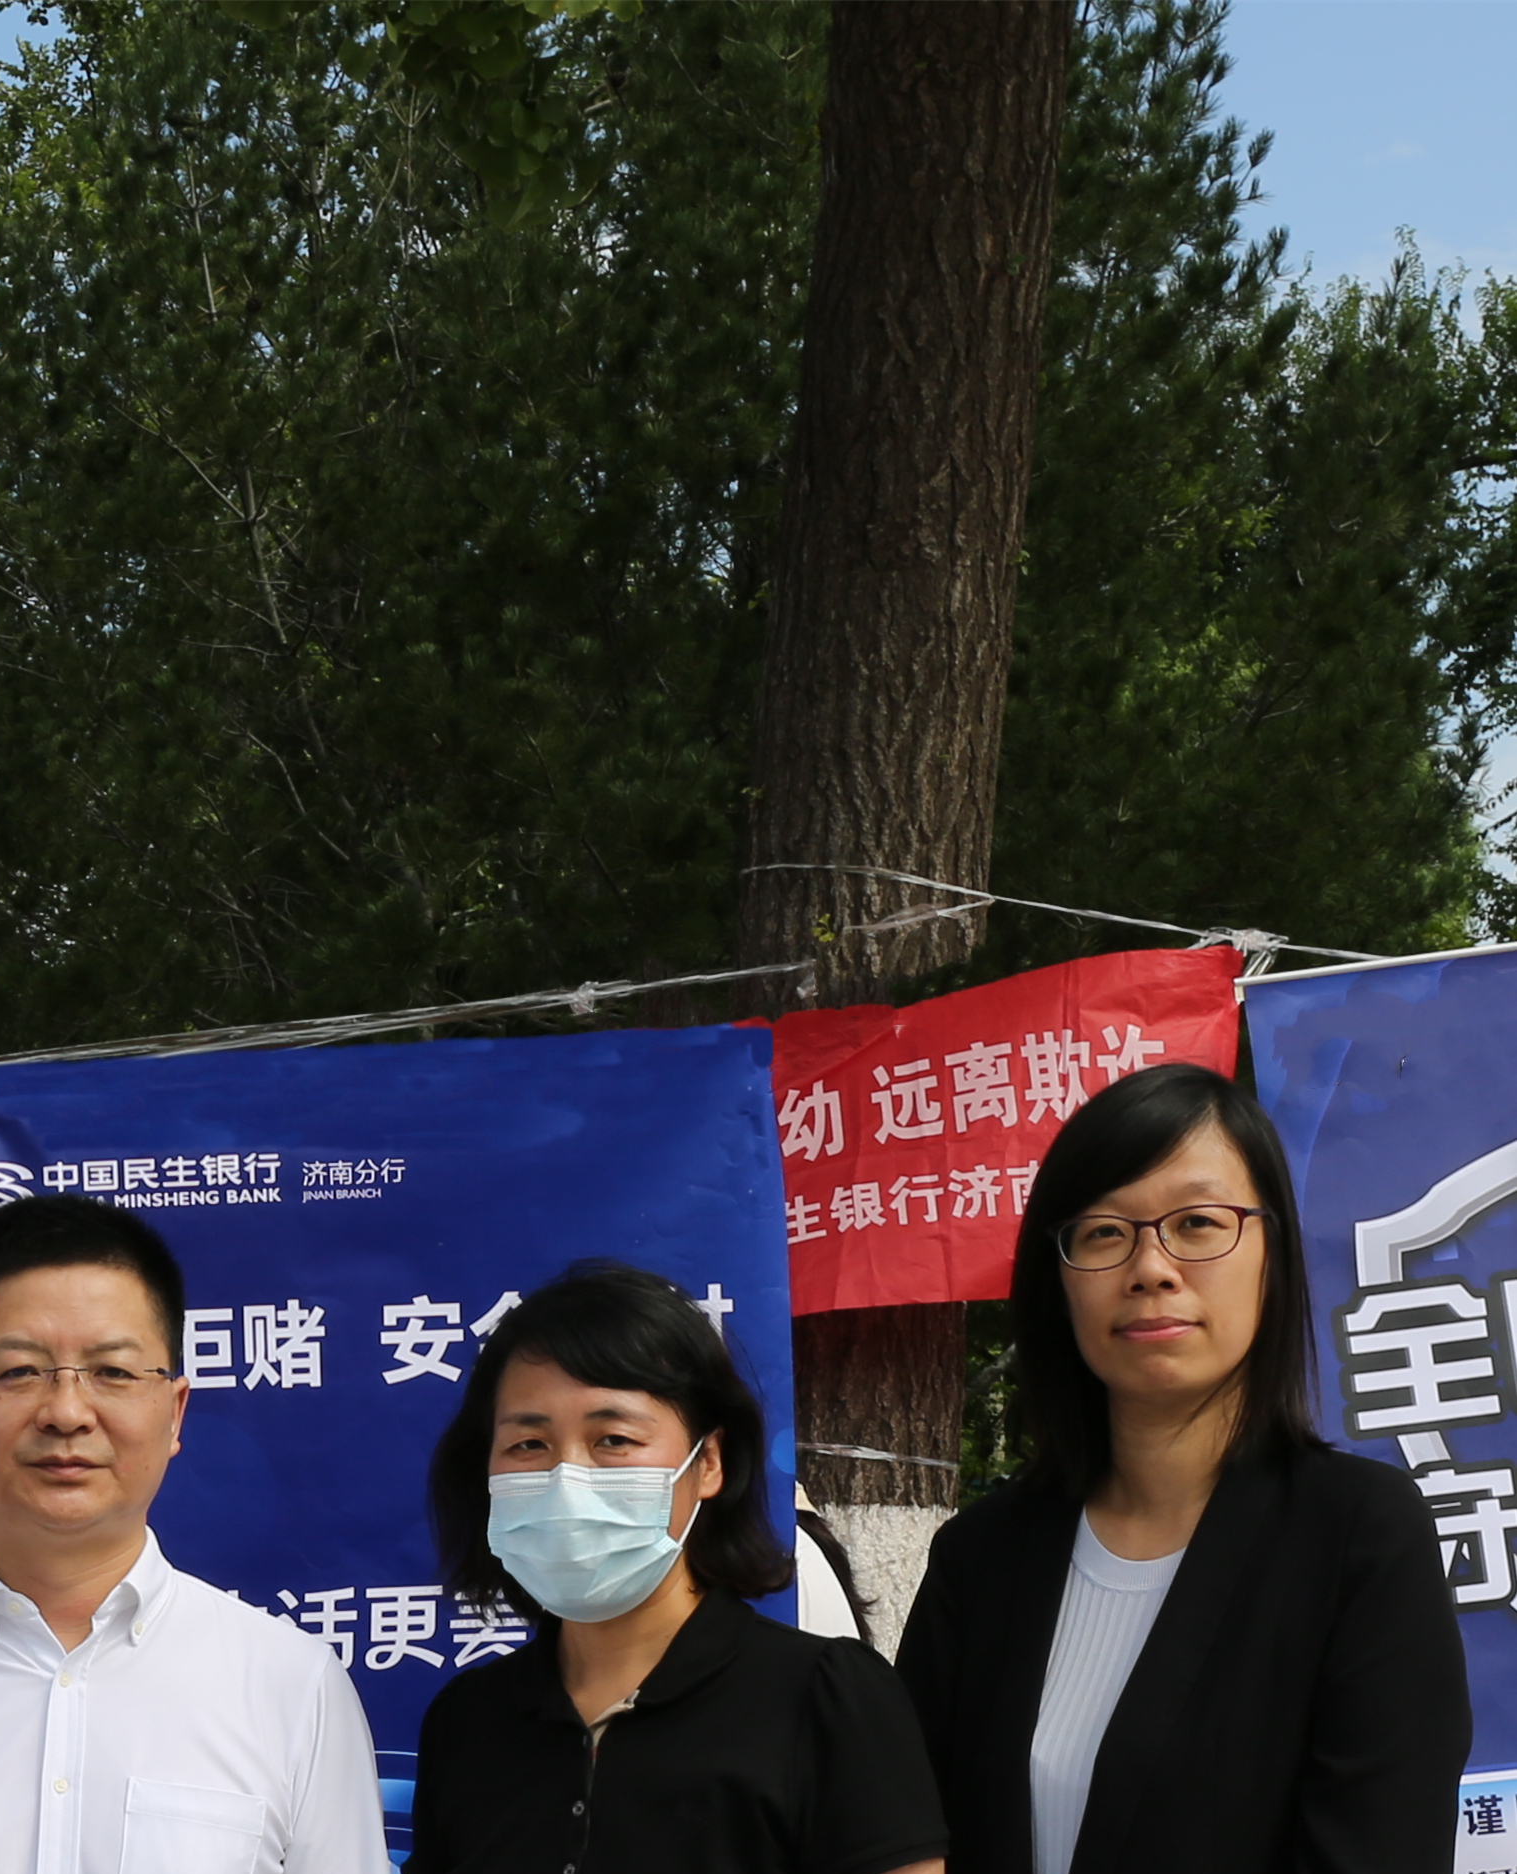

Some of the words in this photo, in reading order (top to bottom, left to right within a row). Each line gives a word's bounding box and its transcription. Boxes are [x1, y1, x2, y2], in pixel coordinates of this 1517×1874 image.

[778, 1080, 844, 1163] 幼
[42, 1152, 281, 1193] 中国民生银行
[301, 1157, 406, 1187] 济南分行
[114, 1191, 221, 1208] MINSHENG
[226, 1187, 281, 1204] BANK
[301, 1189, 334, 1204] JINAN
[335, 1187, 382, 1200] BRANCH
